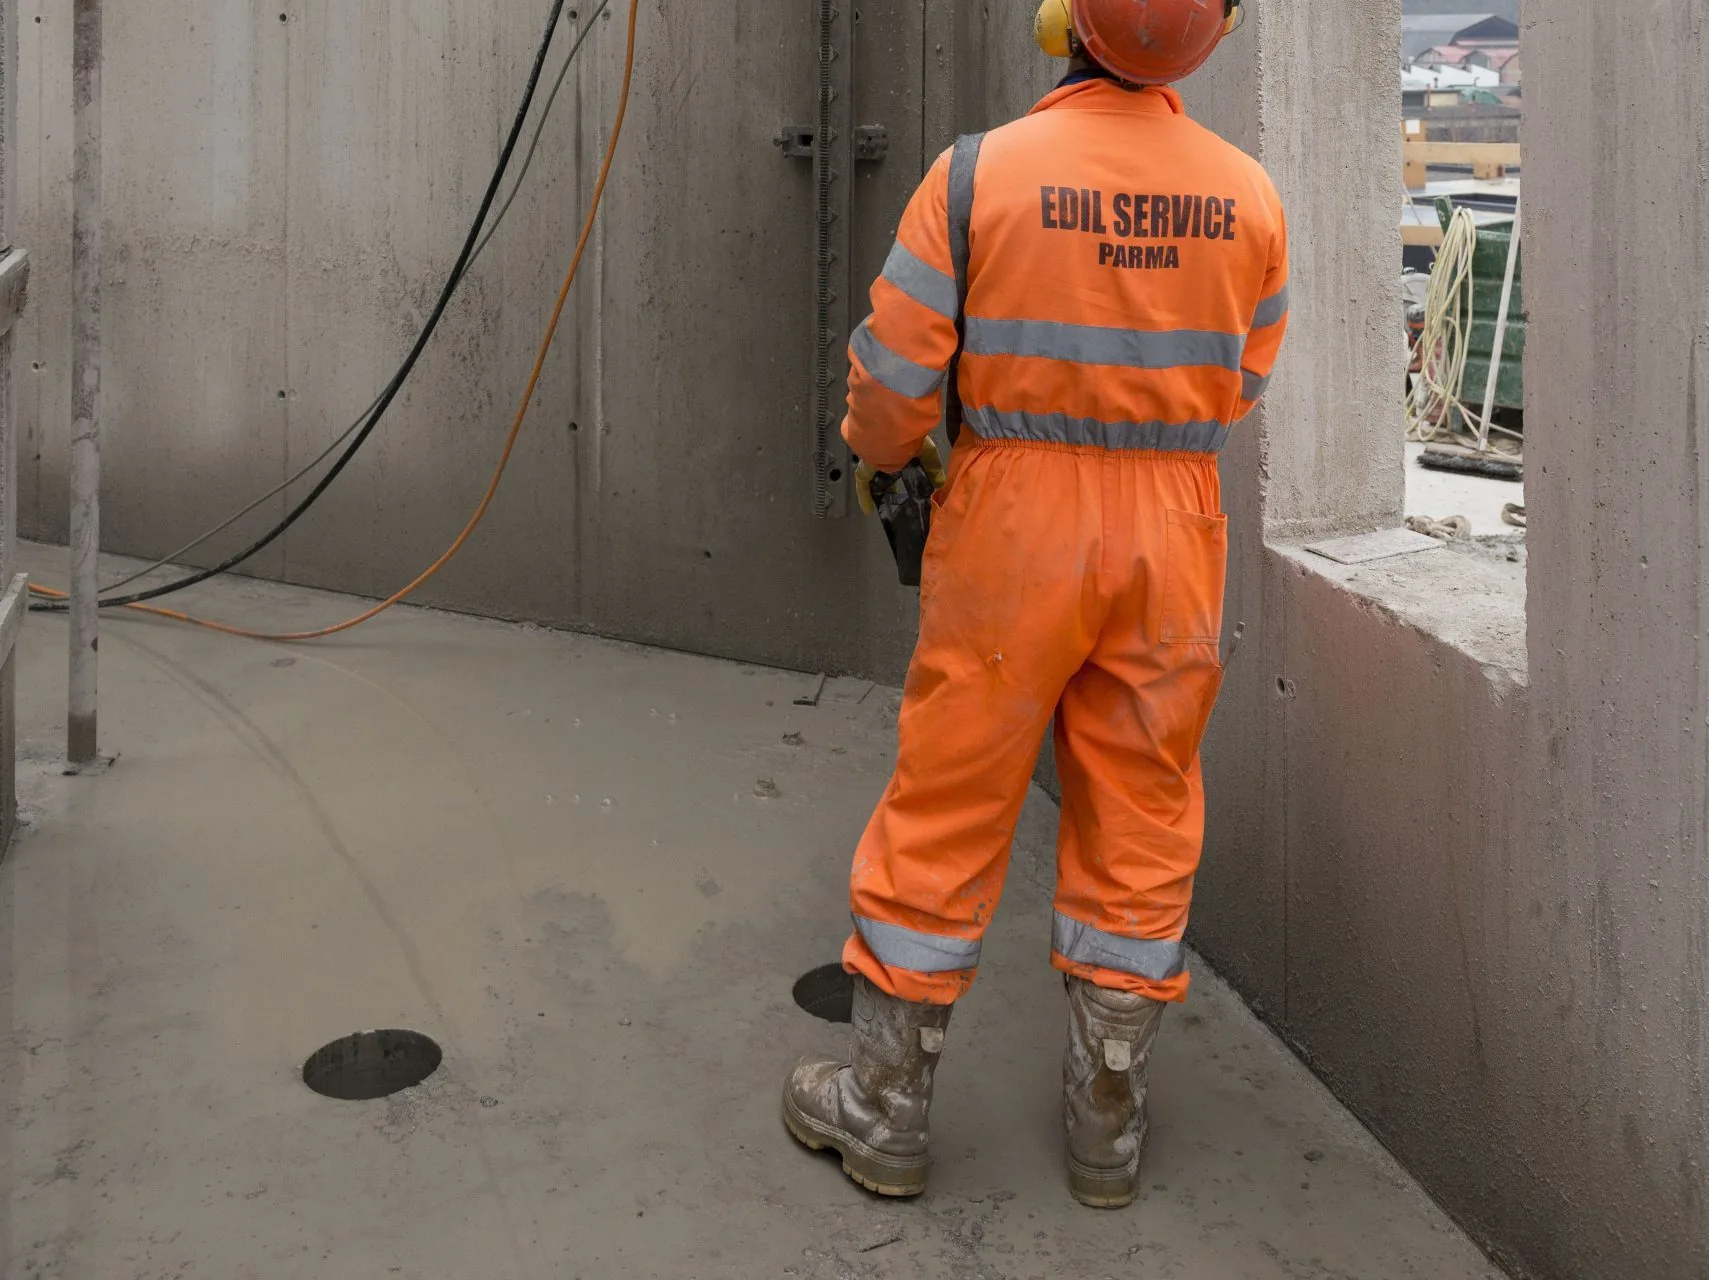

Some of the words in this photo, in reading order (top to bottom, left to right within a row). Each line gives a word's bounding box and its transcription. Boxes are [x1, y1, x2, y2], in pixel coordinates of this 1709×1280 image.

[1040, 185, 1107, 235] EDIL
[1112, 192, 1236, 241] SERVICE
[1098, 242, 1180, 270] PARMA
